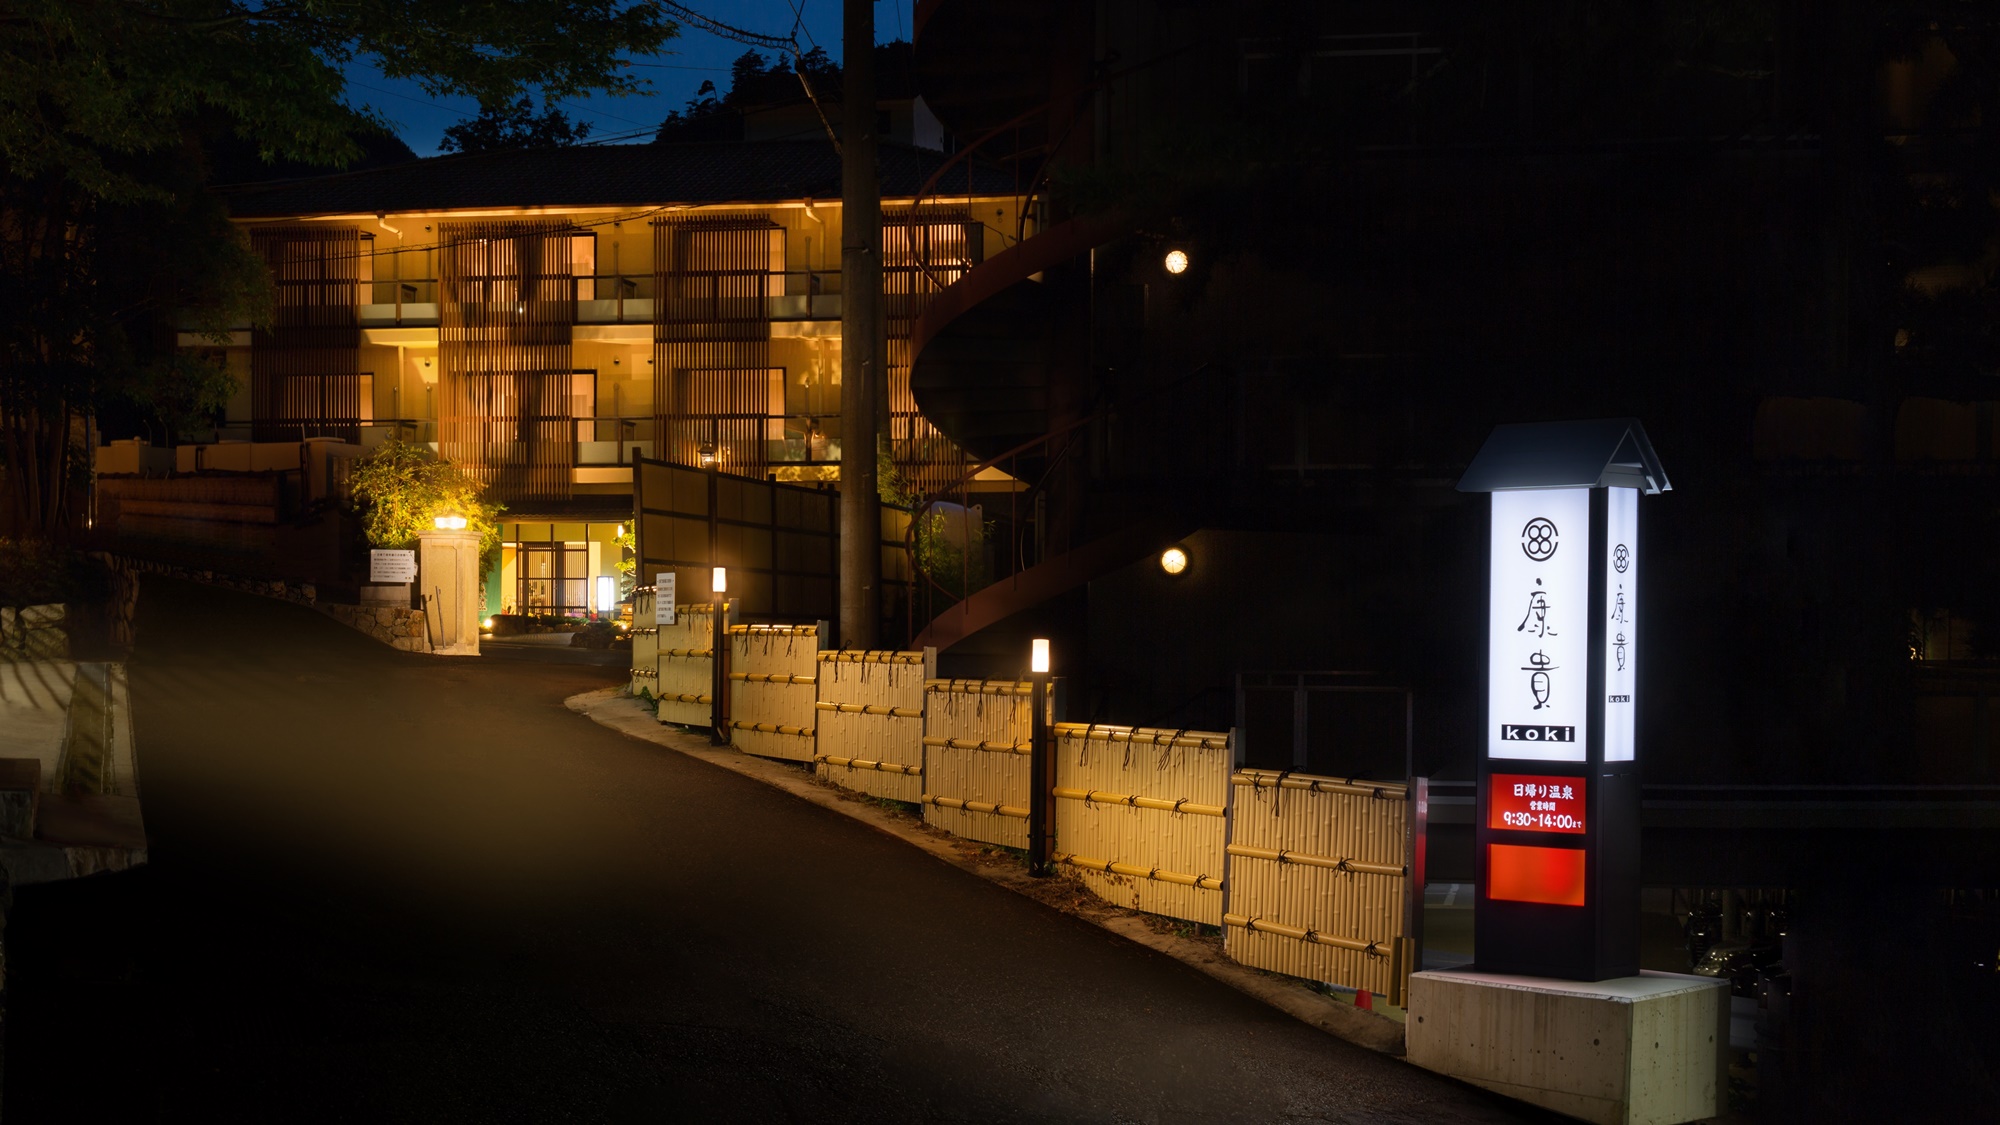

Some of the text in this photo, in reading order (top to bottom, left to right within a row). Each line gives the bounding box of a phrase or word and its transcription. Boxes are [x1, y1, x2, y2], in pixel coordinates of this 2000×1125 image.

[1517, 577, 1560, 710] 康貴
[1609, 695, 1630, 703] koki
[1506, 725, 1571, 741] koki
[1513, 783, 1574, 800] 日帰り温泉
[1529, 801, 1556, 812] 営業時間
